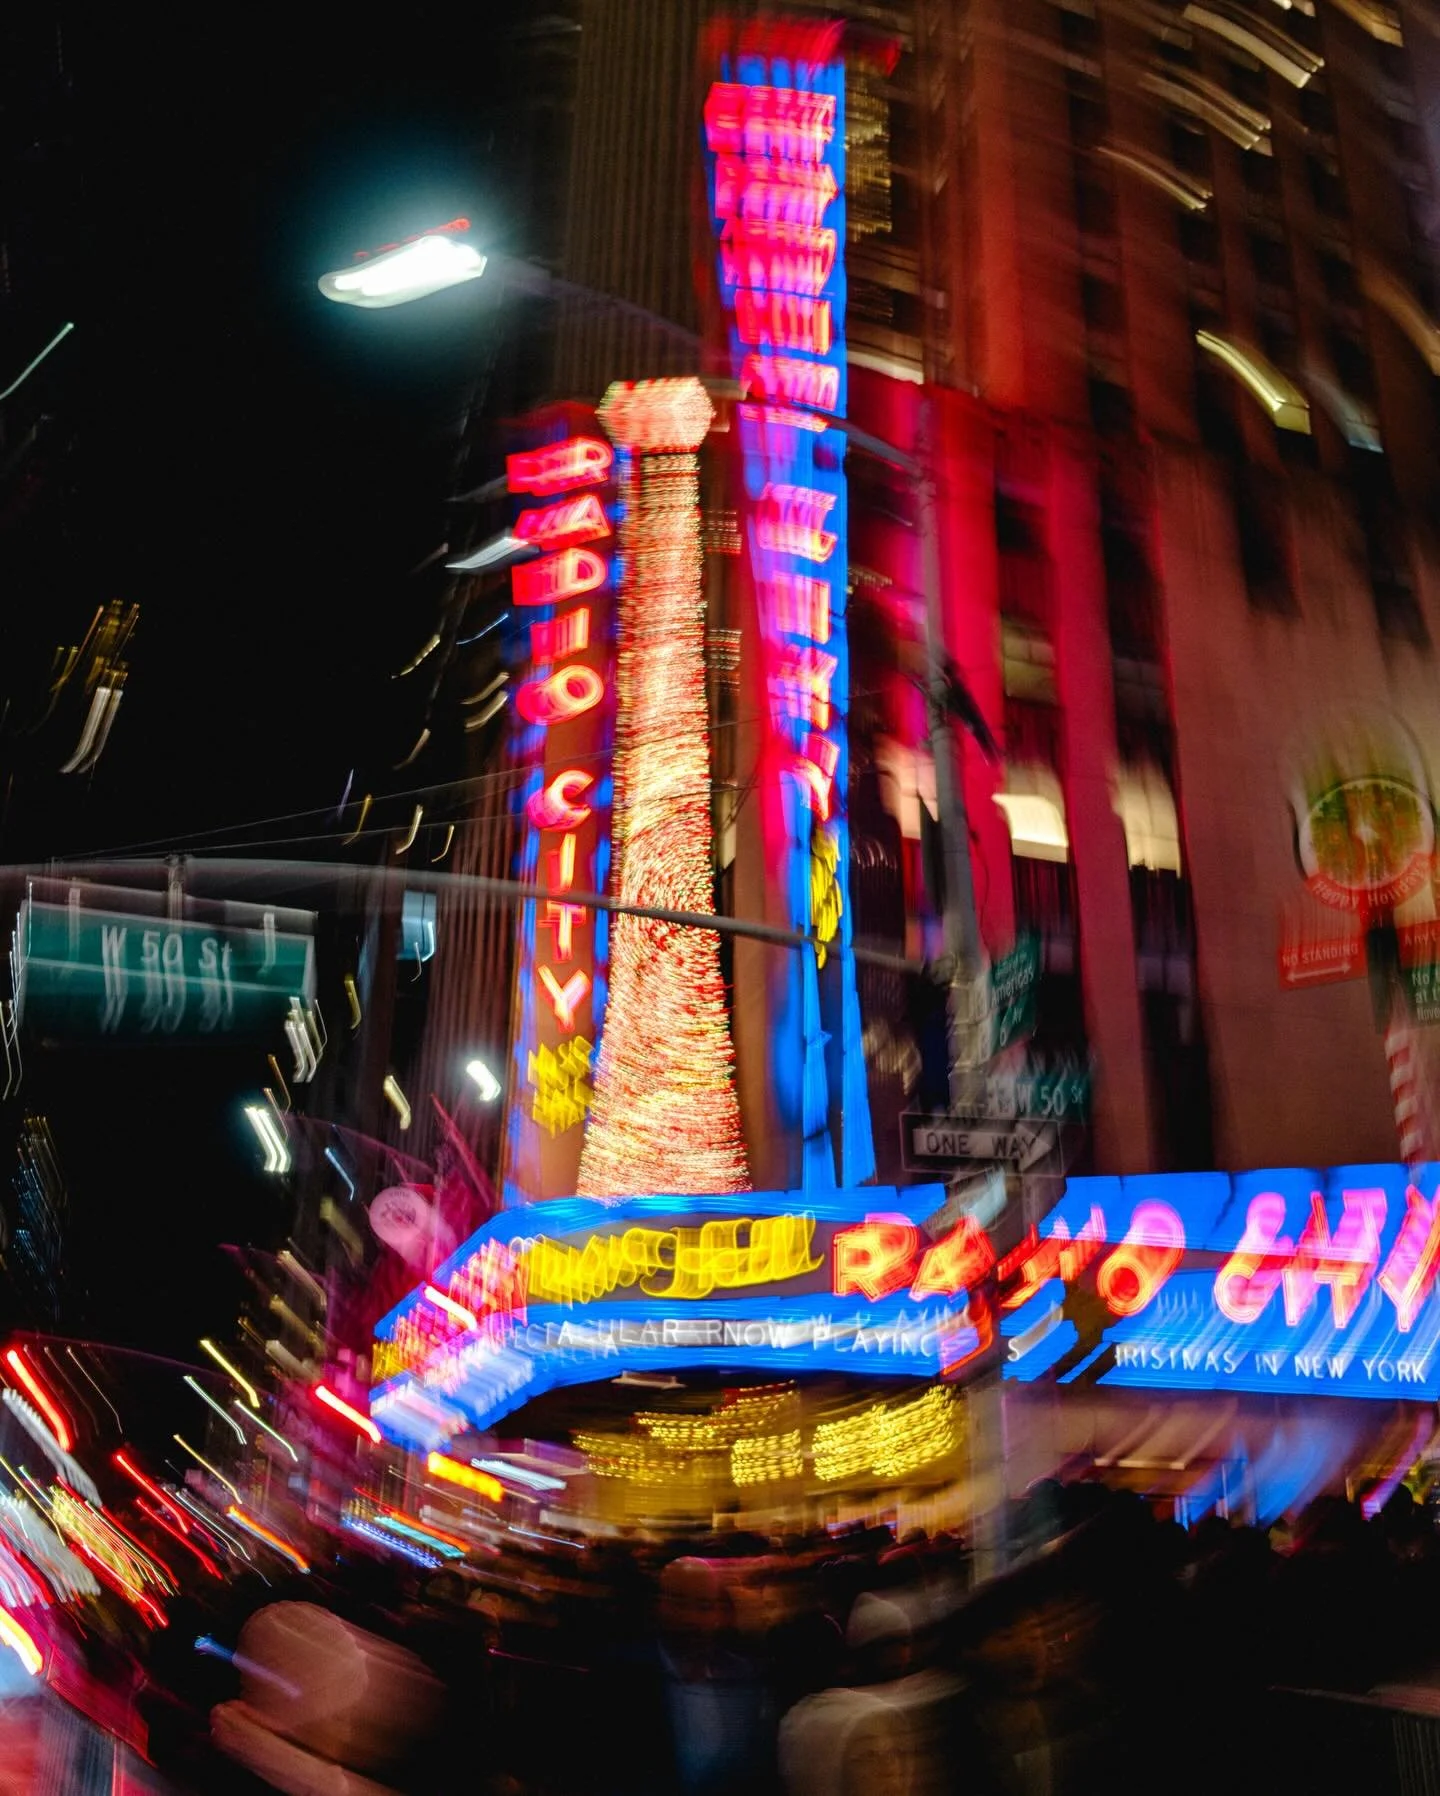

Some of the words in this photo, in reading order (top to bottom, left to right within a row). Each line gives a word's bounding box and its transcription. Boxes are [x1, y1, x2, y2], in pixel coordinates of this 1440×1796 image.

[507, 437, 613, 724] RADIO
[527, 769, 594, 1033] CITY
[1282, 953, 1298, 968] NO
[1302, 943, 1359, 964] STANDING
[1041, 1085, 1065, 1116] 50
[926, 1131, 972, 1155] ONE
[991, 1134, 1038, 1161] WAY
[1214, 1188, 1440, 1333] CITY
[1114, 1344, 1235, 1374] RISTMAS
[1255, 1353, 1279, 1377] IN
[1294, 1353, 1345, 1380] NEW
[1362, 1358, 1427, 1385] YORK
